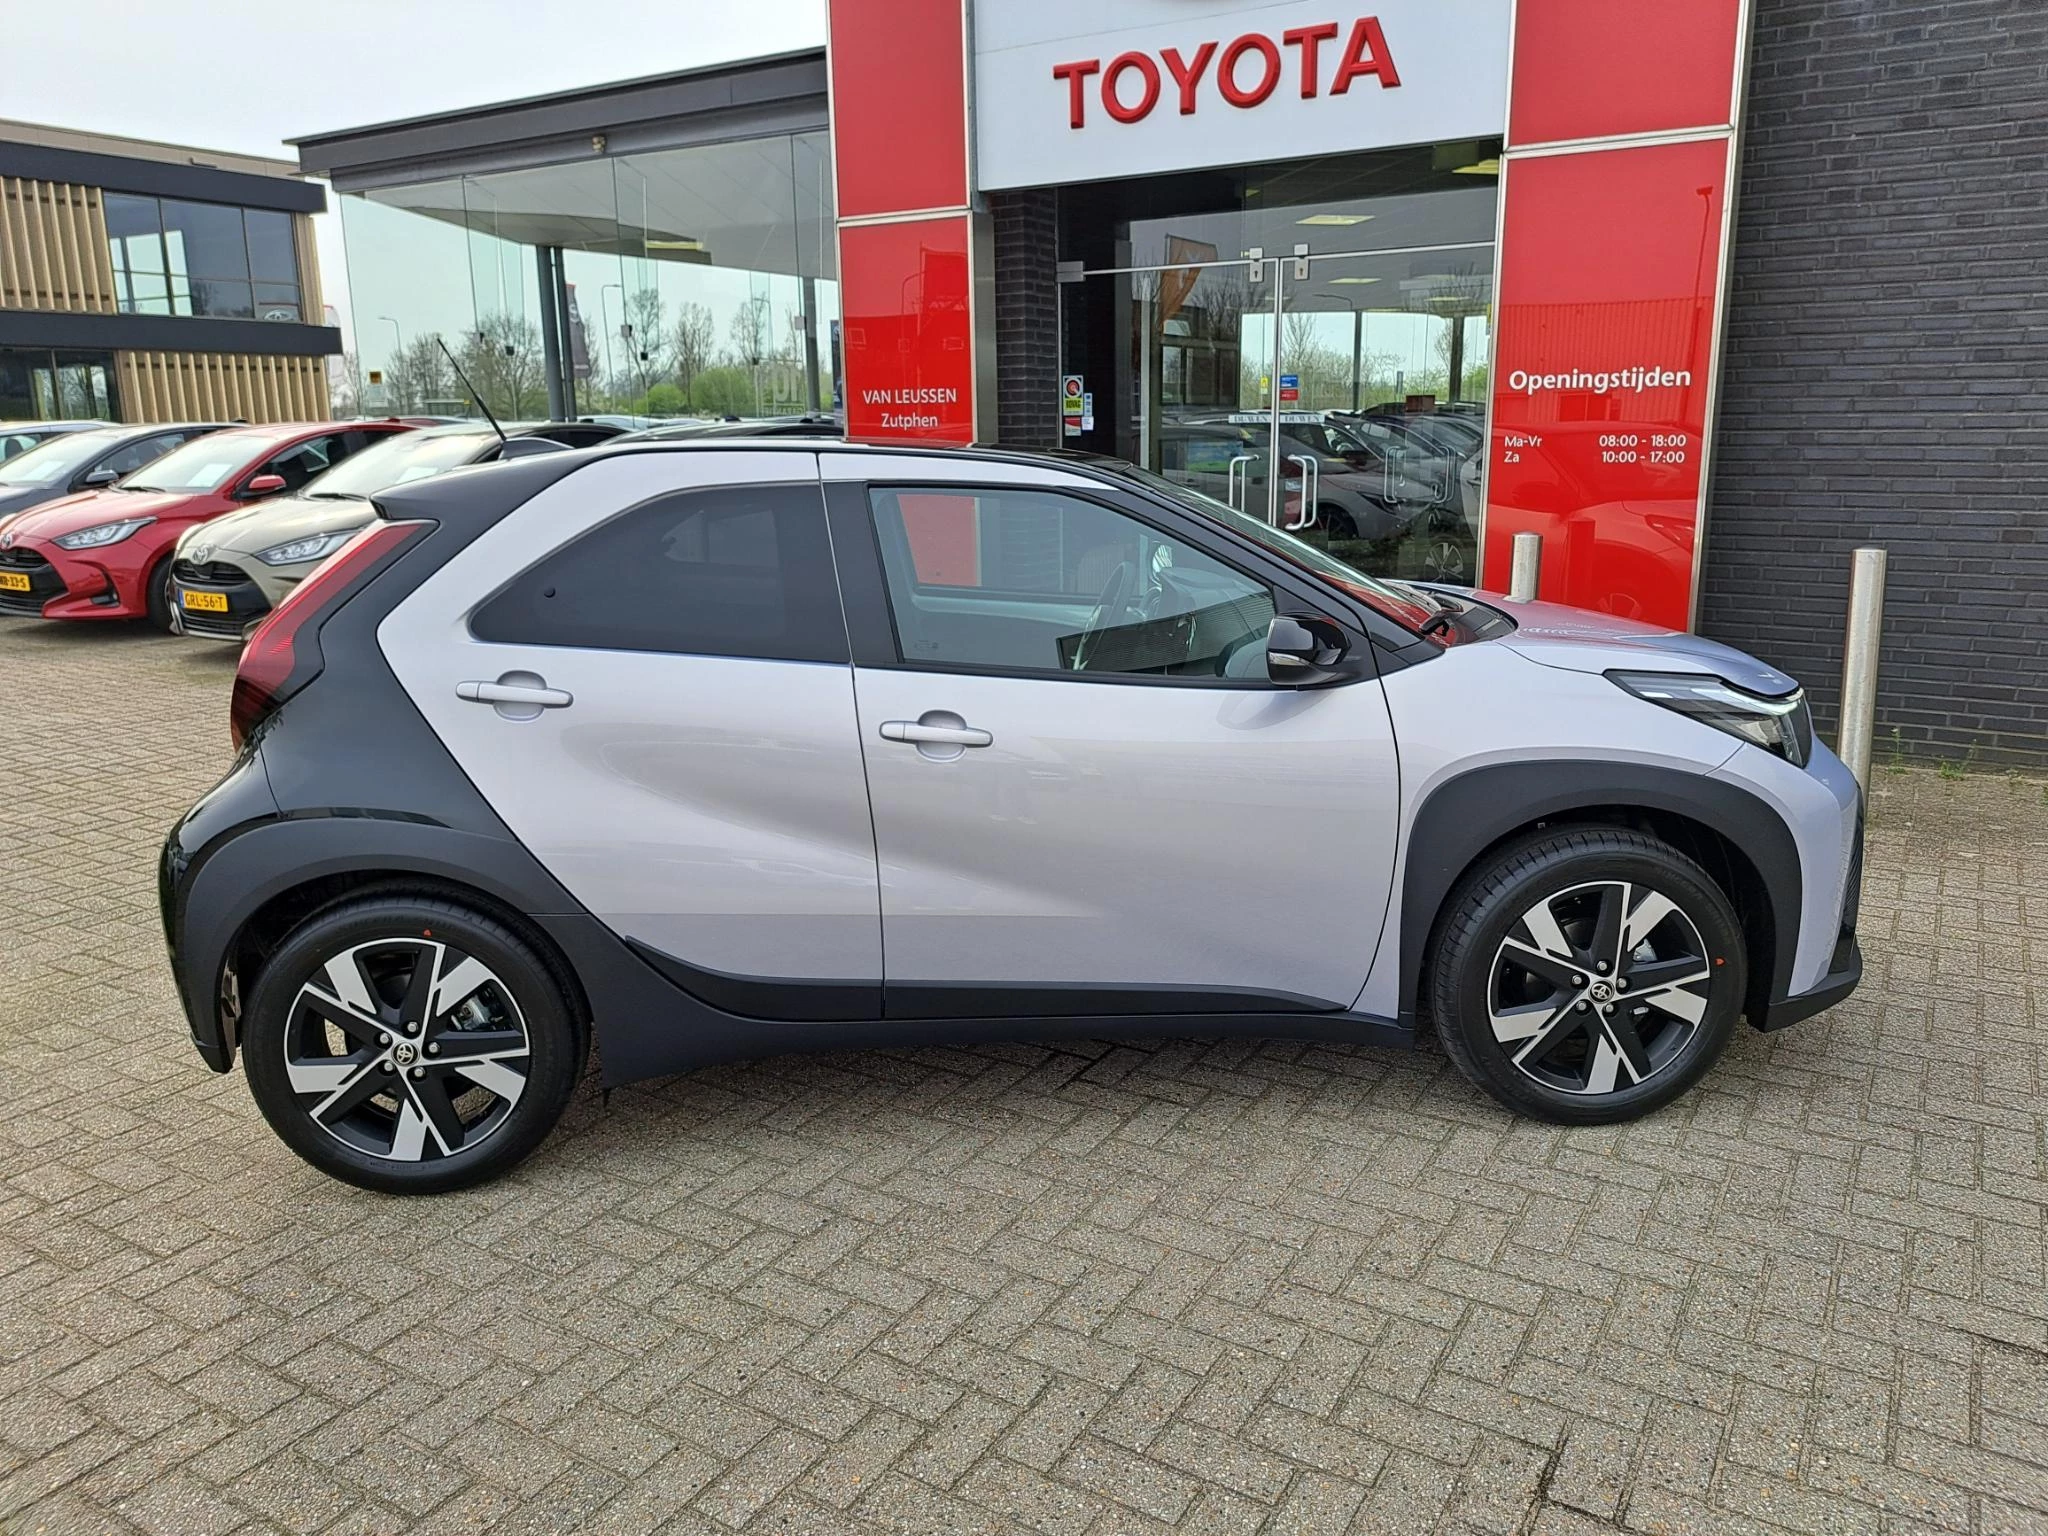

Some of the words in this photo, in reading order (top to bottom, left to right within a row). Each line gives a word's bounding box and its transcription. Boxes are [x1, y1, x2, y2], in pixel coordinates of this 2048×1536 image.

[1053, 16, 1402, 129] TOYOTA
[1509, 366, 1691, 395] Openingstijden
[862, 389, 891, 404] VAN
[895, 388, 957, 404] LEUSSEN
[881, 412, 938, 431] Zutphen
[1504, 435, 1542, 447] Ma-Vr
[1599, 434, 1637, 447] 08:00
[1651, 434, 1687, 447] 18:00
[1504, 451, 1520, 463] Za
[1602, 451, 1637, 463] 10:00
[1650, 451, 1685, 463] 17:00
[185, 593, 224, 608] GRL-56-T
